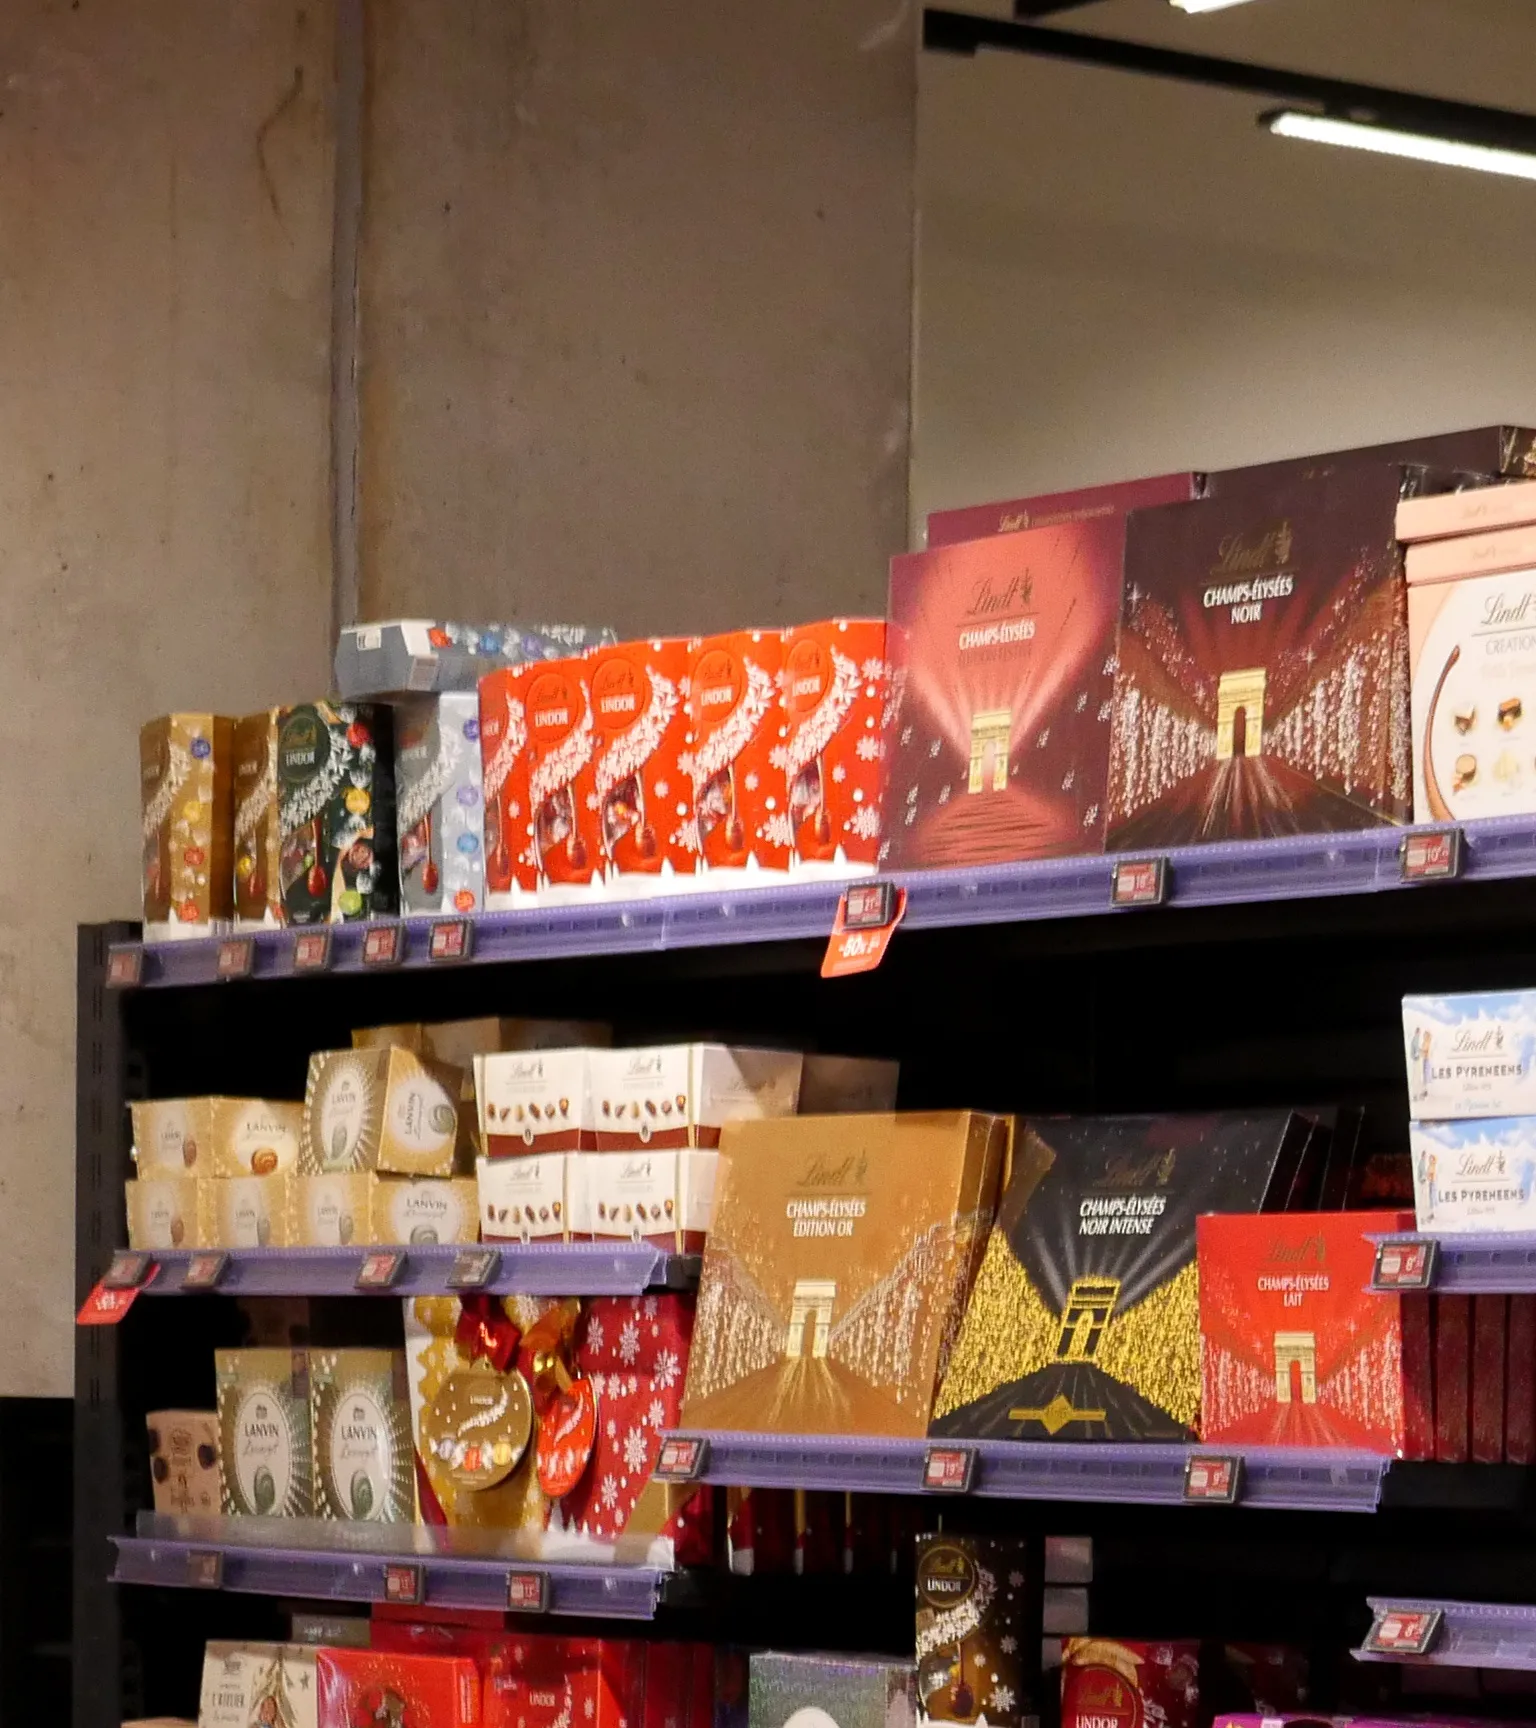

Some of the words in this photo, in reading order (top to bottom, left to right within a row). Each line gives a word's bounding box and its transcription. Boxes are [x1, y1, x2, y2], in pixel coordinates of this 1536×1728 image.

[1204, 574, 1293, 609] CHAMPS-ÉLYSÉES
[1231, 604, 1262, 624] NOIR
[1480, 591, 1532, 626] Lindt
[959, 619, 1036, 650] CHAMPS-ÉLYSÉES
[1451, 1029, 1493, 1052] Lindt
[1432, 1066, 1451, 1080] LES
[1456, 1154, 1494, 1176] Lindt
[406, 1199, 448, 1210] LANVIN
[1079, 1194, 1165, 1217] CHAMPS-ÉLYSÉES
[1438, 1190, 1458, 1203] LES
[785, 1199, 866, 1221] CHAMPS-ÉLYSÉES
[793, 1216, 835, 1238] ÉDITION
[838, 1218, 854, 1237] OR
[1079, 1216, 1108, 1236] NOIR
[1110, 1216, 1153, 1235] INTENSE
[1257, 1273, 1331, 1293] CHAMPS-ÉLYSÉES
[1283, 1292, 1303, 1308] LAIT
[244, 1424, 278, 1438] LANVIN
[341, 1425, 377, 1439] LANVIN
[926, 1577, 962, 1592] LINDOR
